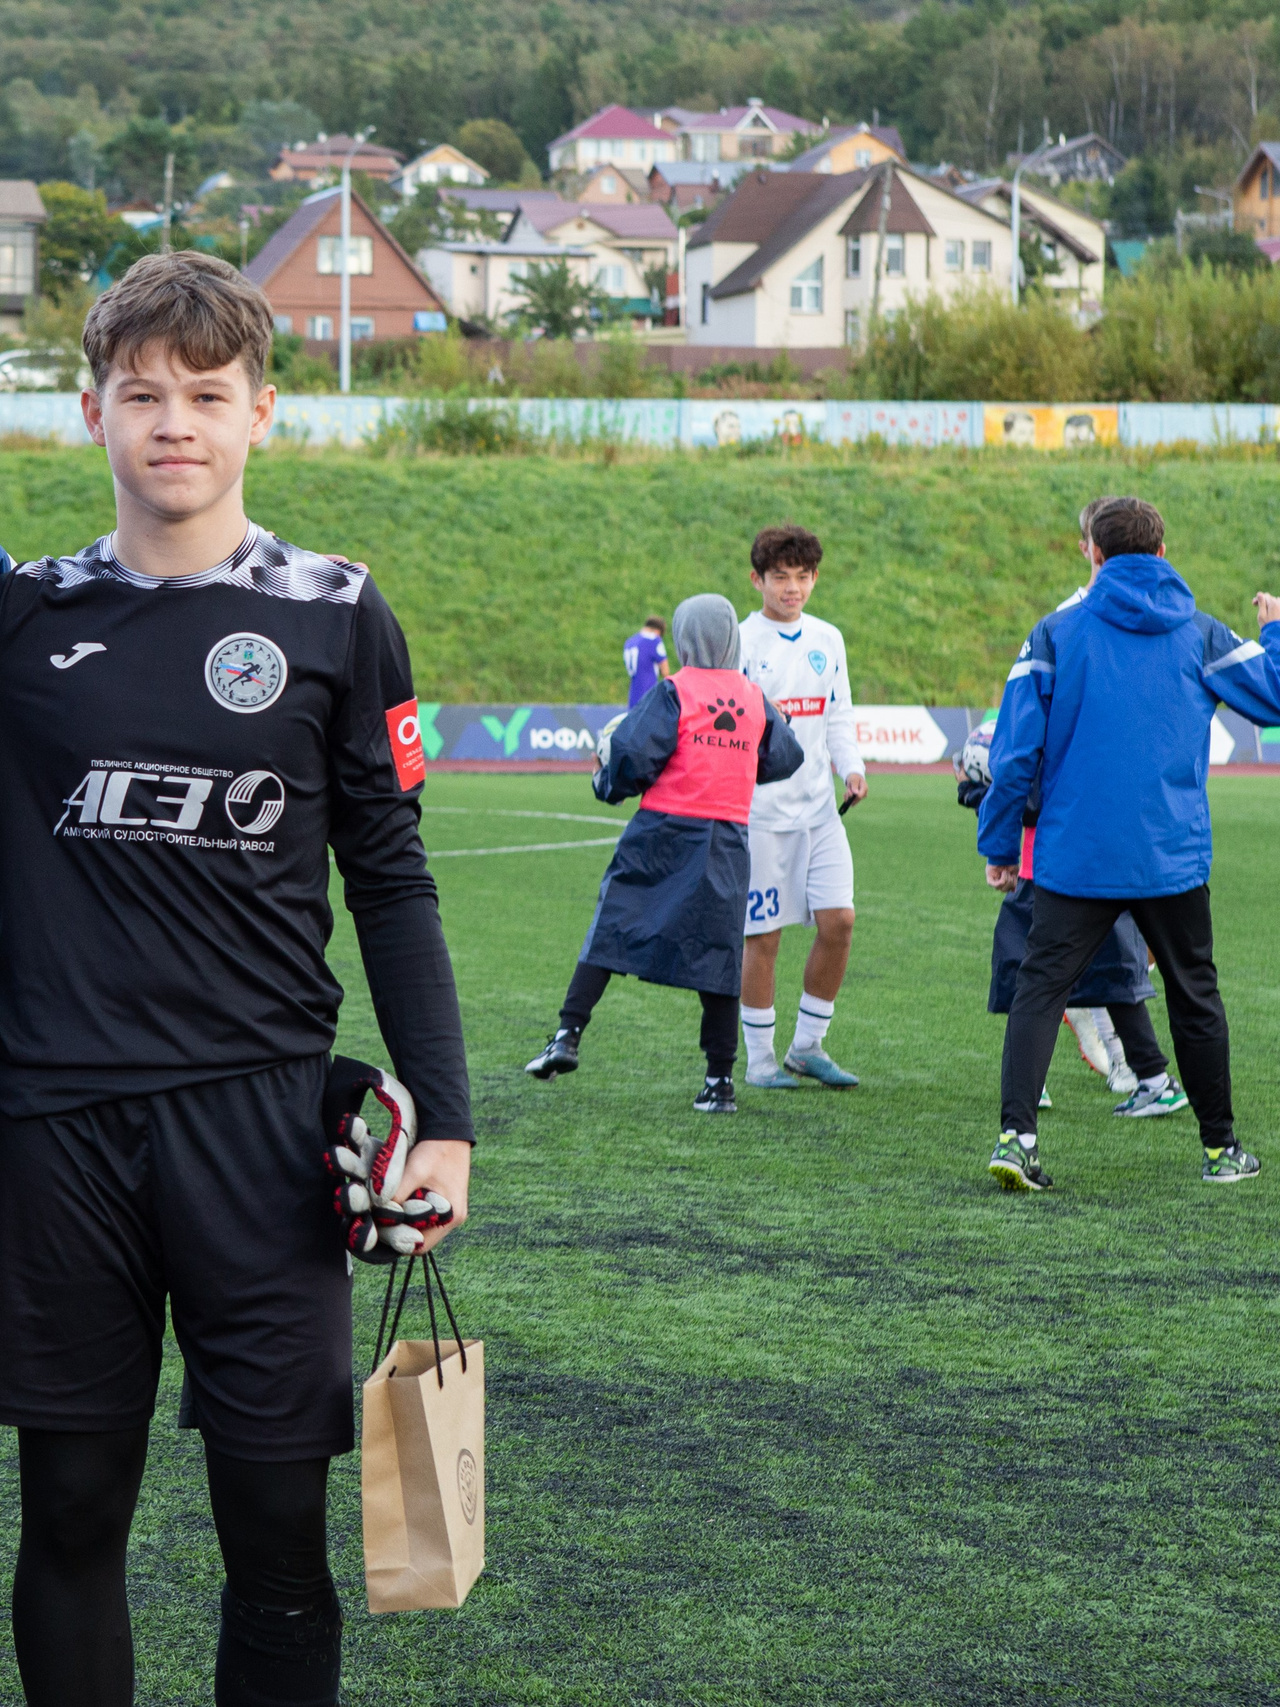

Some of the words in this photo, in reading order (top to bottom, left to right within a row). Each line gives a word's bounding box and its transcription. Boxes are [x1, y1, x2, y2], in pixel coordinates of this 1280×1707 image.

[530, 727, 595, 751] ЮФЛ
[693, 733, 751, 751] KELME
[856, 721, 925, 746] Банк
[91, 760, 133, 769] ПУБЛИЧНОЕ
[134, 762, 190, 774] АКЦИОНЕРНОЕ
[191, 767, 234, 778] ОБЩЕСТВО
[53, 770, 213, 834] АСЗ
[113, 830, 238, 850] СУДОСТРОИТЕЛЬНЫЙ
[240, 841, 275, 853] ЗАВОД
[748, 886, 780, 921] 23
